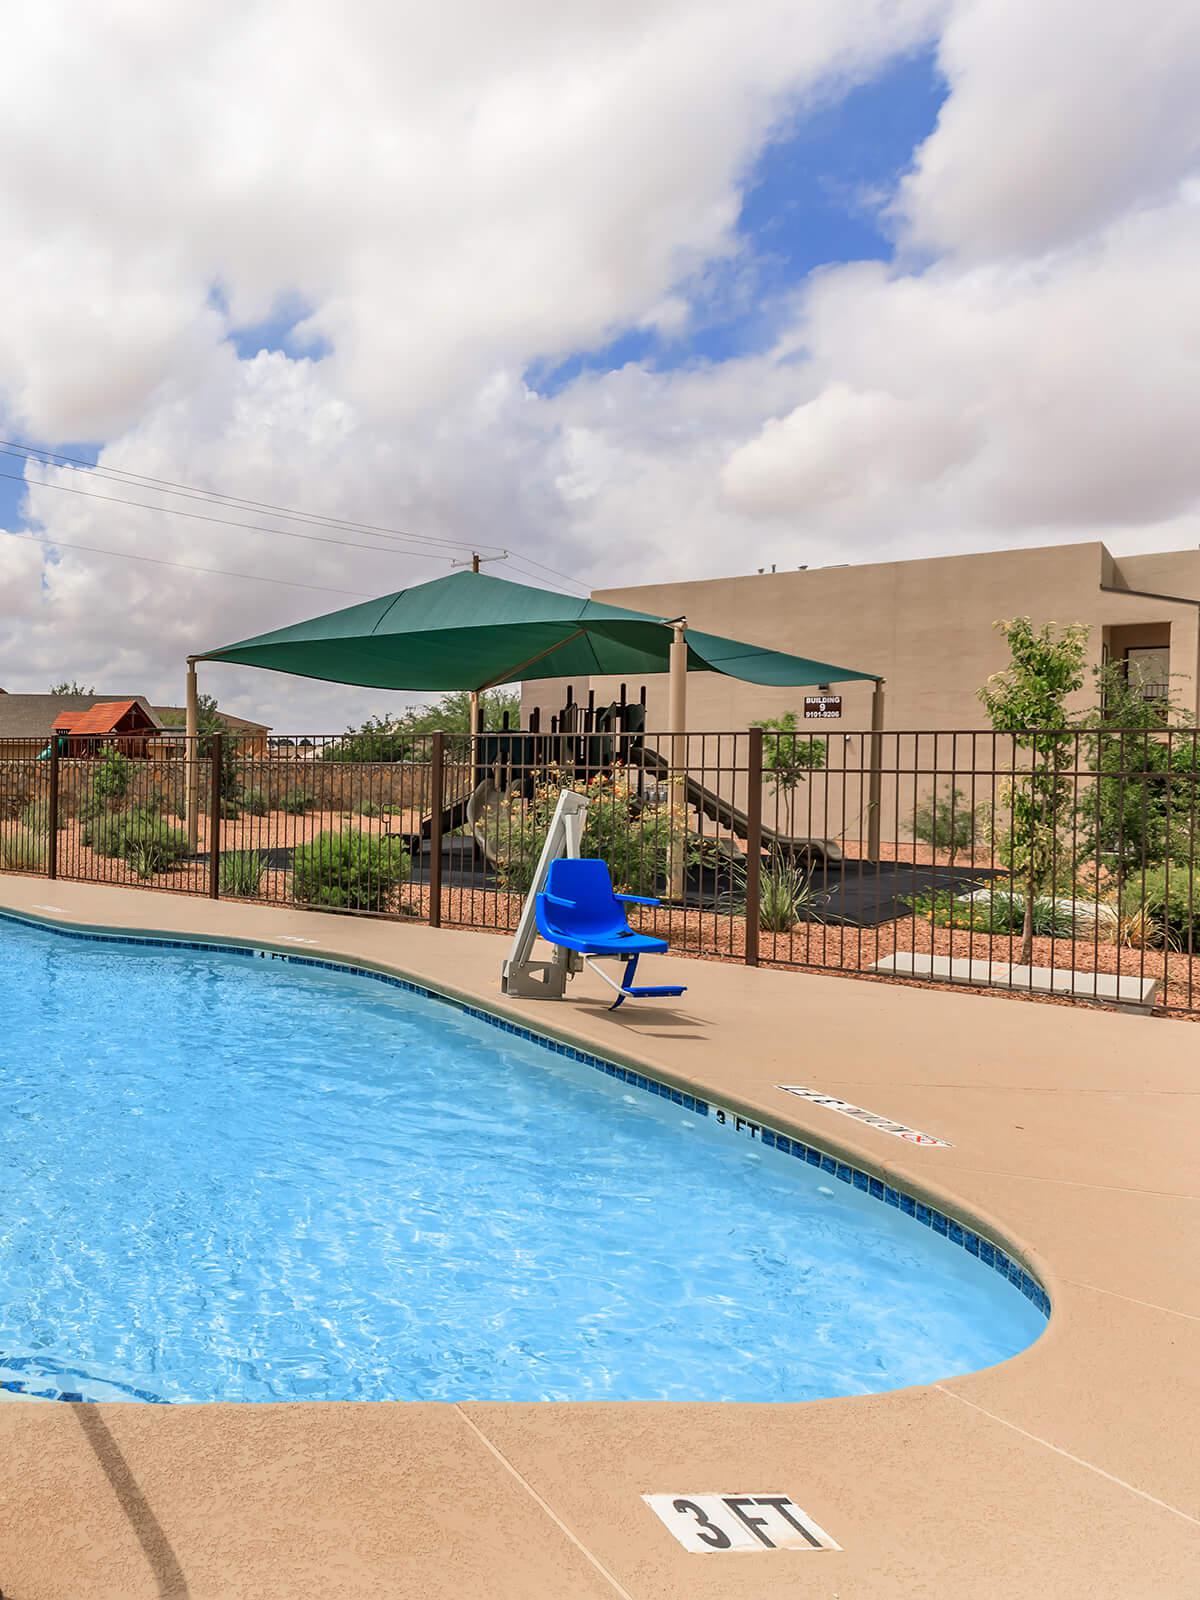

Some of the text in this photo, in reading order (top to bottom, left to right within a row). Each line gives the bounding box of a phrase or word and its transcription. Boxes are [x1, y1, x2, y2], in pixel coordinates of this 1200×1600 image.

[819, 703, 826, 711] 9
[716, 1109, 760, 1138] 3 FT
[673, 1497, 823, 1549] 3 FT
